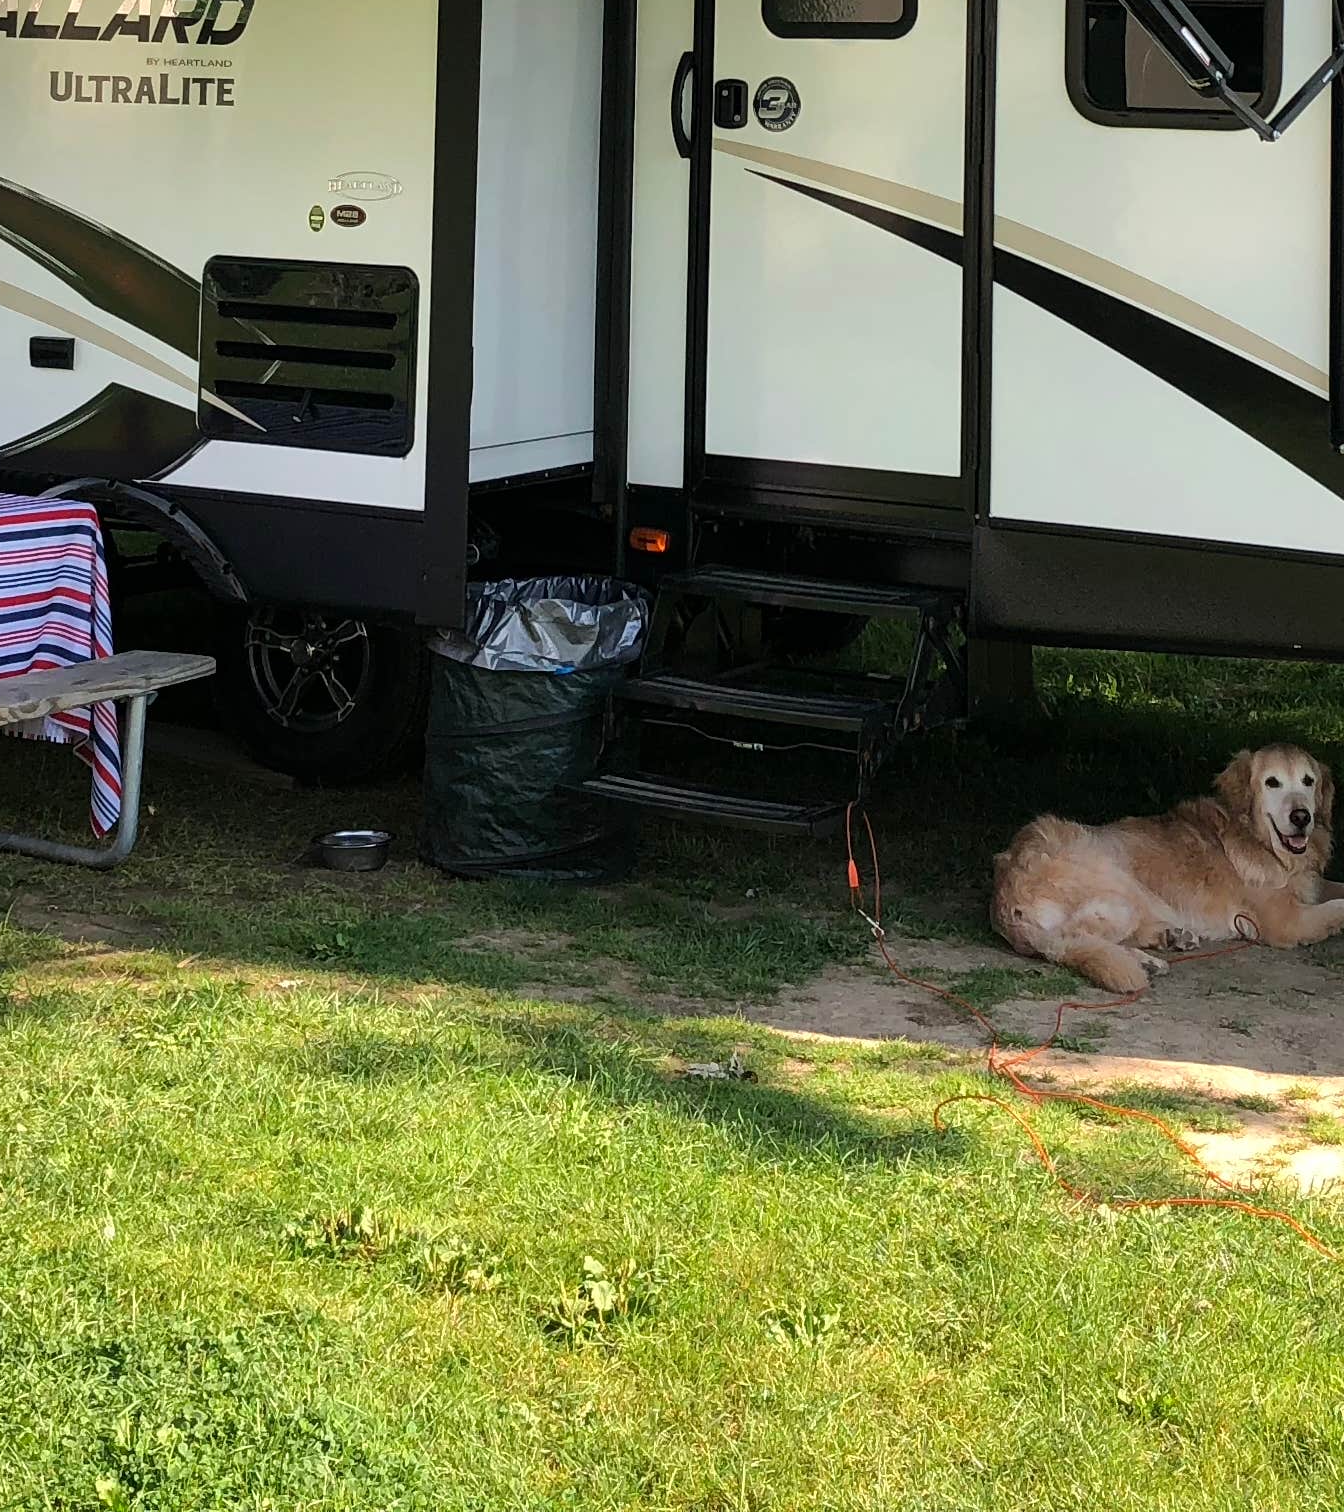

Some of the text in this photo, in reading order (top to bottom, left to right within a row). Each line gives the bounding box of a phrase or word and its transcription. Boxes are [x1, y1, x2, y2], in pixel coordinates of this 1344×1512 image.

[146, 57, 233, 68] BY HEARTLAND
[758, 89, 788, 118] 3
